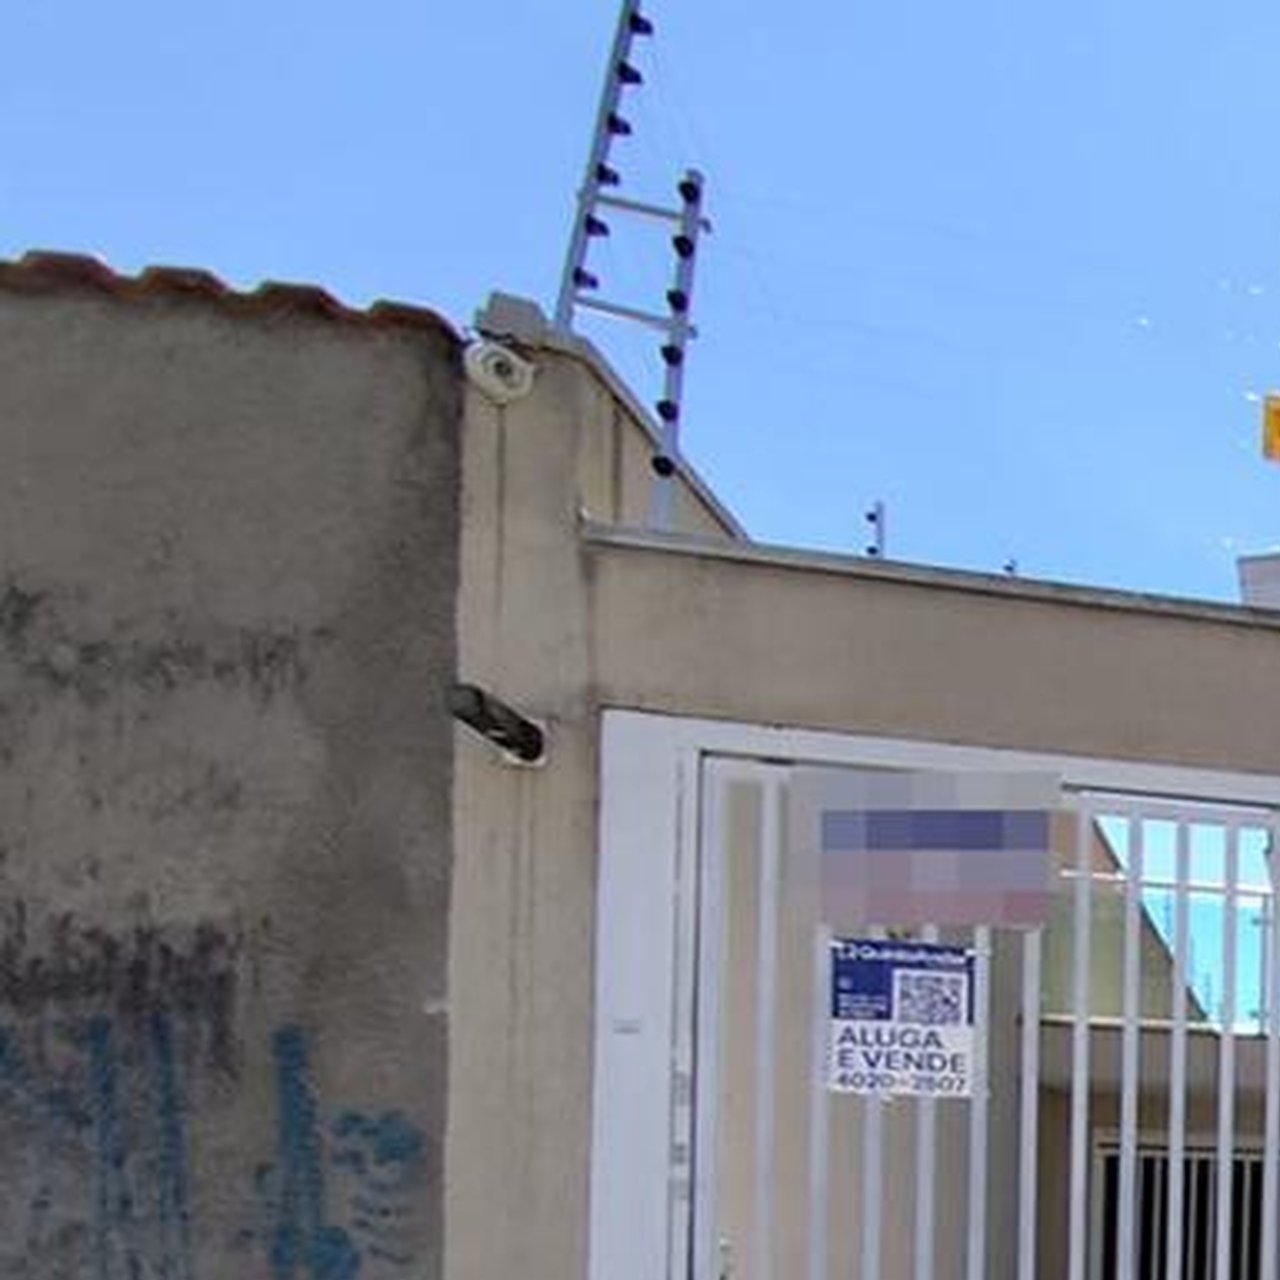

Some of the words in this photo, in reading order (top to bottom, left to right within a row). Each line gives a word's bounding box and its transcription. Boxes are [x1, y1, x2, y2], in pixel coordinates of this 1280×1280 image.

[838, 1027, 943, 1049] ALUGA
[838, 1049, 855, 1069] E
[862, 1051, 966, 1074] VENDE
